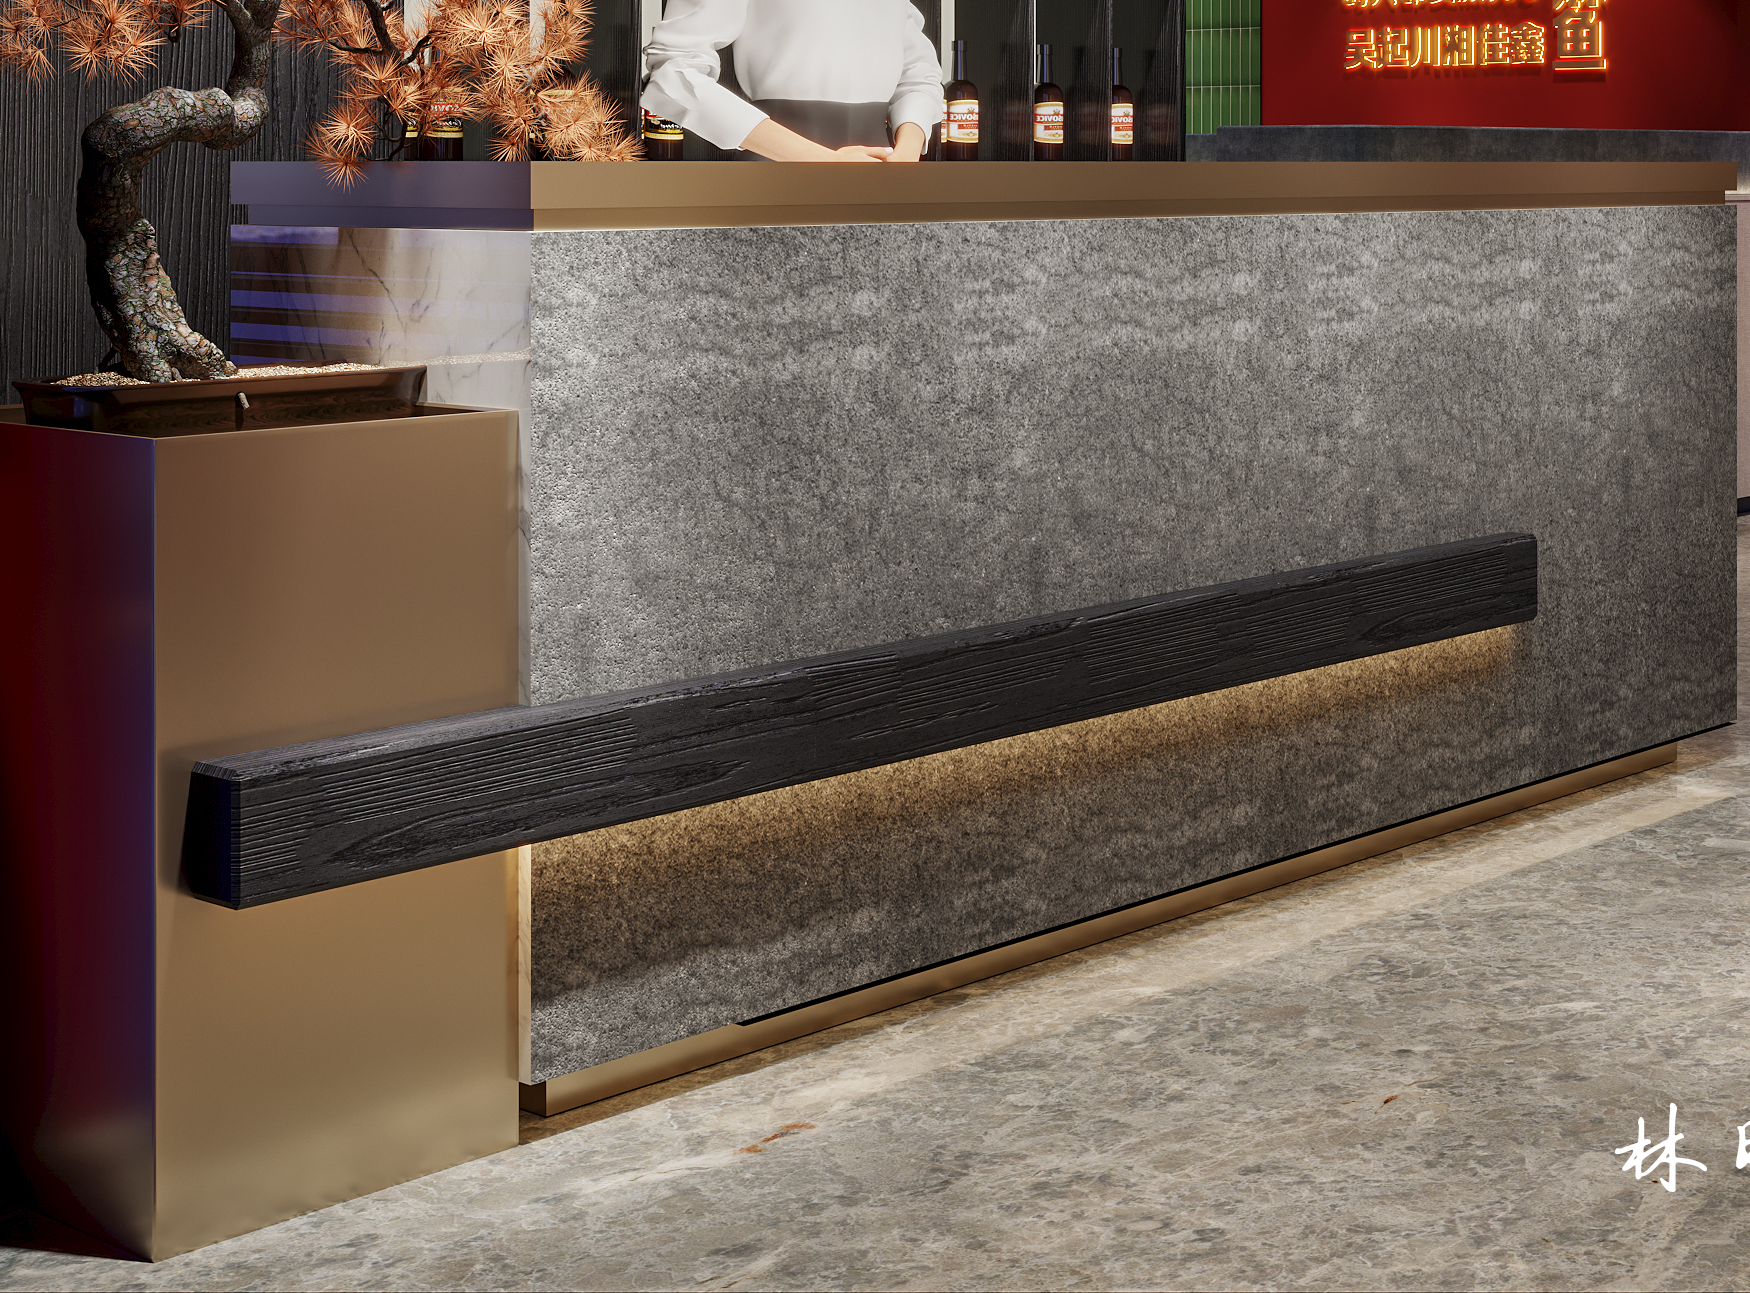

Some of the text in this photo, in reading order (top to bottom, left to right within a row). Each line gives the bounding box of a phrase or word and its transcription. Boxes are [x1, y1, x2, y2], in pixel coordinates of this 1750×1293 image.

[1344, 21, 1545, 69] 吴起川湘佳鑫
